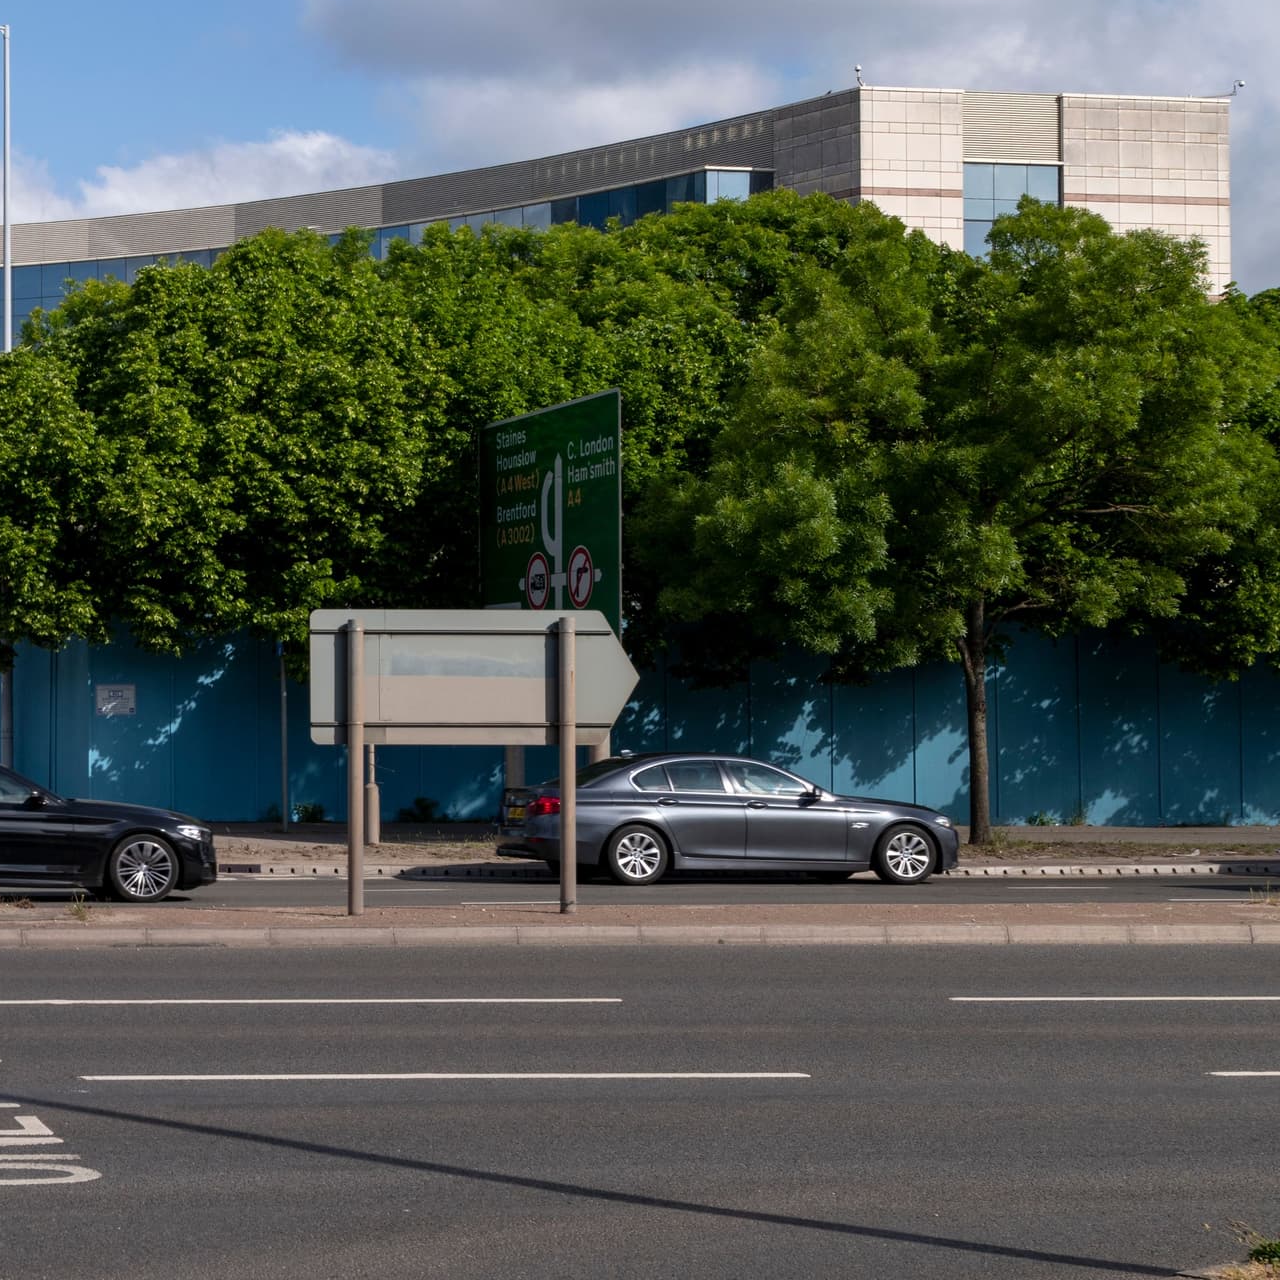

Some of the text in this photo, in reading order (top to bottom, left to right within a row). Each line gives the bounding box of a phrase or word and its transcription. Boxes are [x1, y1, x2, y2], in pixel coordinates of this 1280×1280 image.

[496, 430, 527, 450] Staines
[567, 433, 614, 460] C. London
[496, 449, 537, 472] Hounslow
[567, 456, 615, 484] Ham'smith
[567, 487, 581, 508] A4
[496, 500, 536, 523] Brentford
